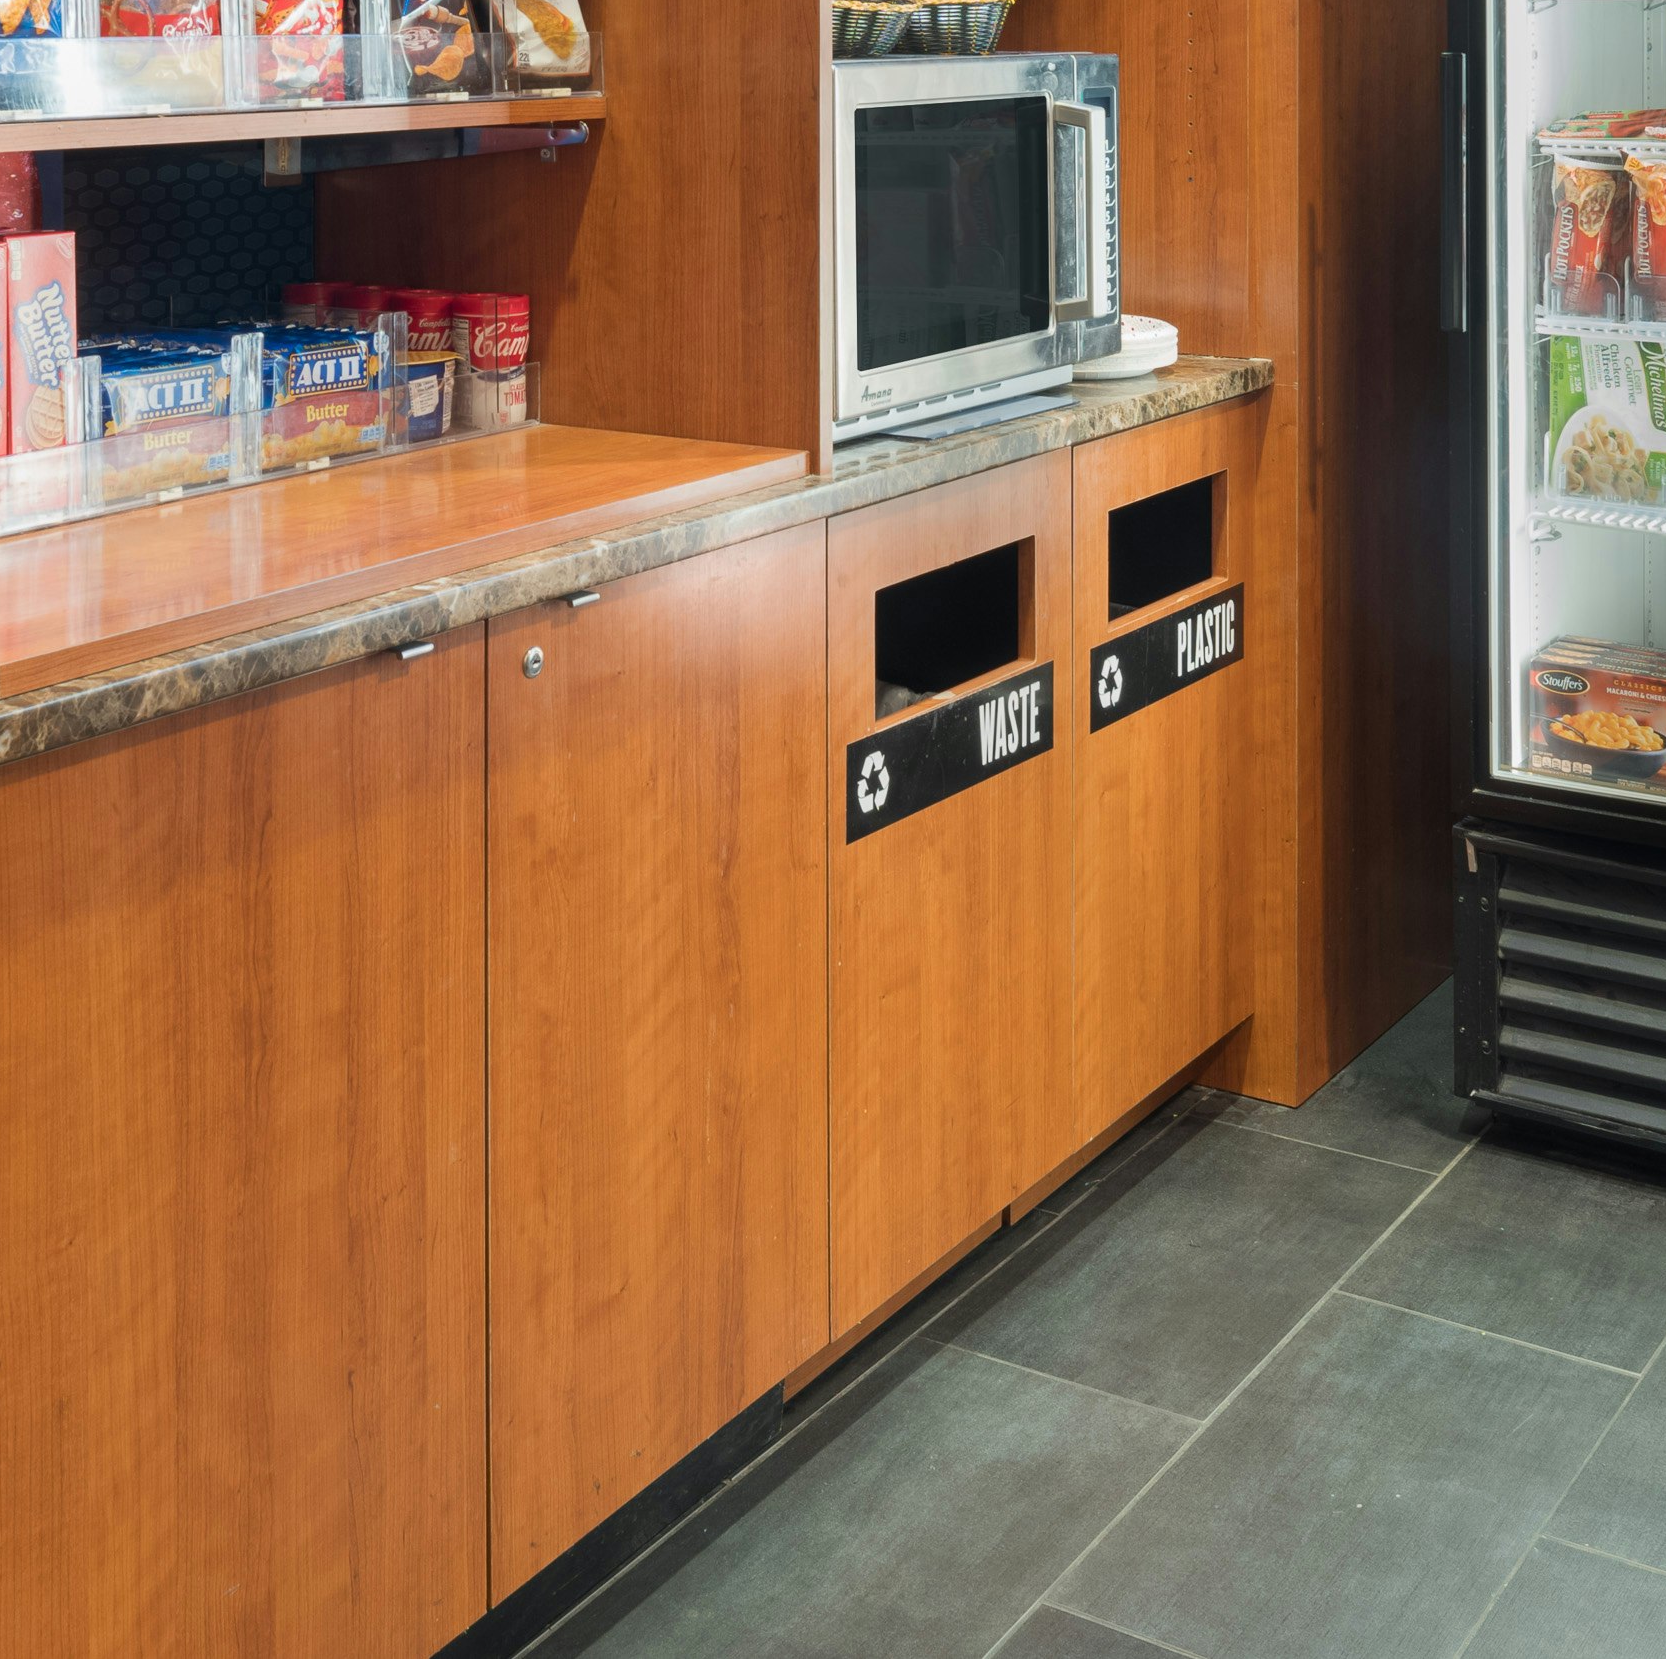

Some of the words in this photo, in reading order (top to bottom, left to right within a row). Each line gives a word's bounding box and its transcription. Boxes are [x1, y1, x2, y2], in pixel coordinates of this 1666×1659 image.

[1556, 205, 1575, 256] POCKETS
[1636, 204, 1652, 256] POCKETS
[1553, 254, 1569, 281] HOT
[1637, 255, 1653, 279] HOT
[35, 280, 72, 370] Nutter
[18, 299, 60, 390] Butter
[297, 359, 337, 387] ACT
[1600, 344, 1612, 389] Alfredo
[1609, 343, 1622, 389] Chicken
[136, 382, 180, 411] ACT
[860, 385, 893, 403] Amana
[306, 402, 350, 423] Butter
[143, 427, 193, 451] Butter
[1177, 599, 1236, 678] PLASTIC
[1542, 673, 1584, 691] Stouffer's
[1606, 687, 1640, 699] MACARONI
[1613, 679, 1663, 693] CLASSICS
[978, 681, 1041, 766] WASTE
